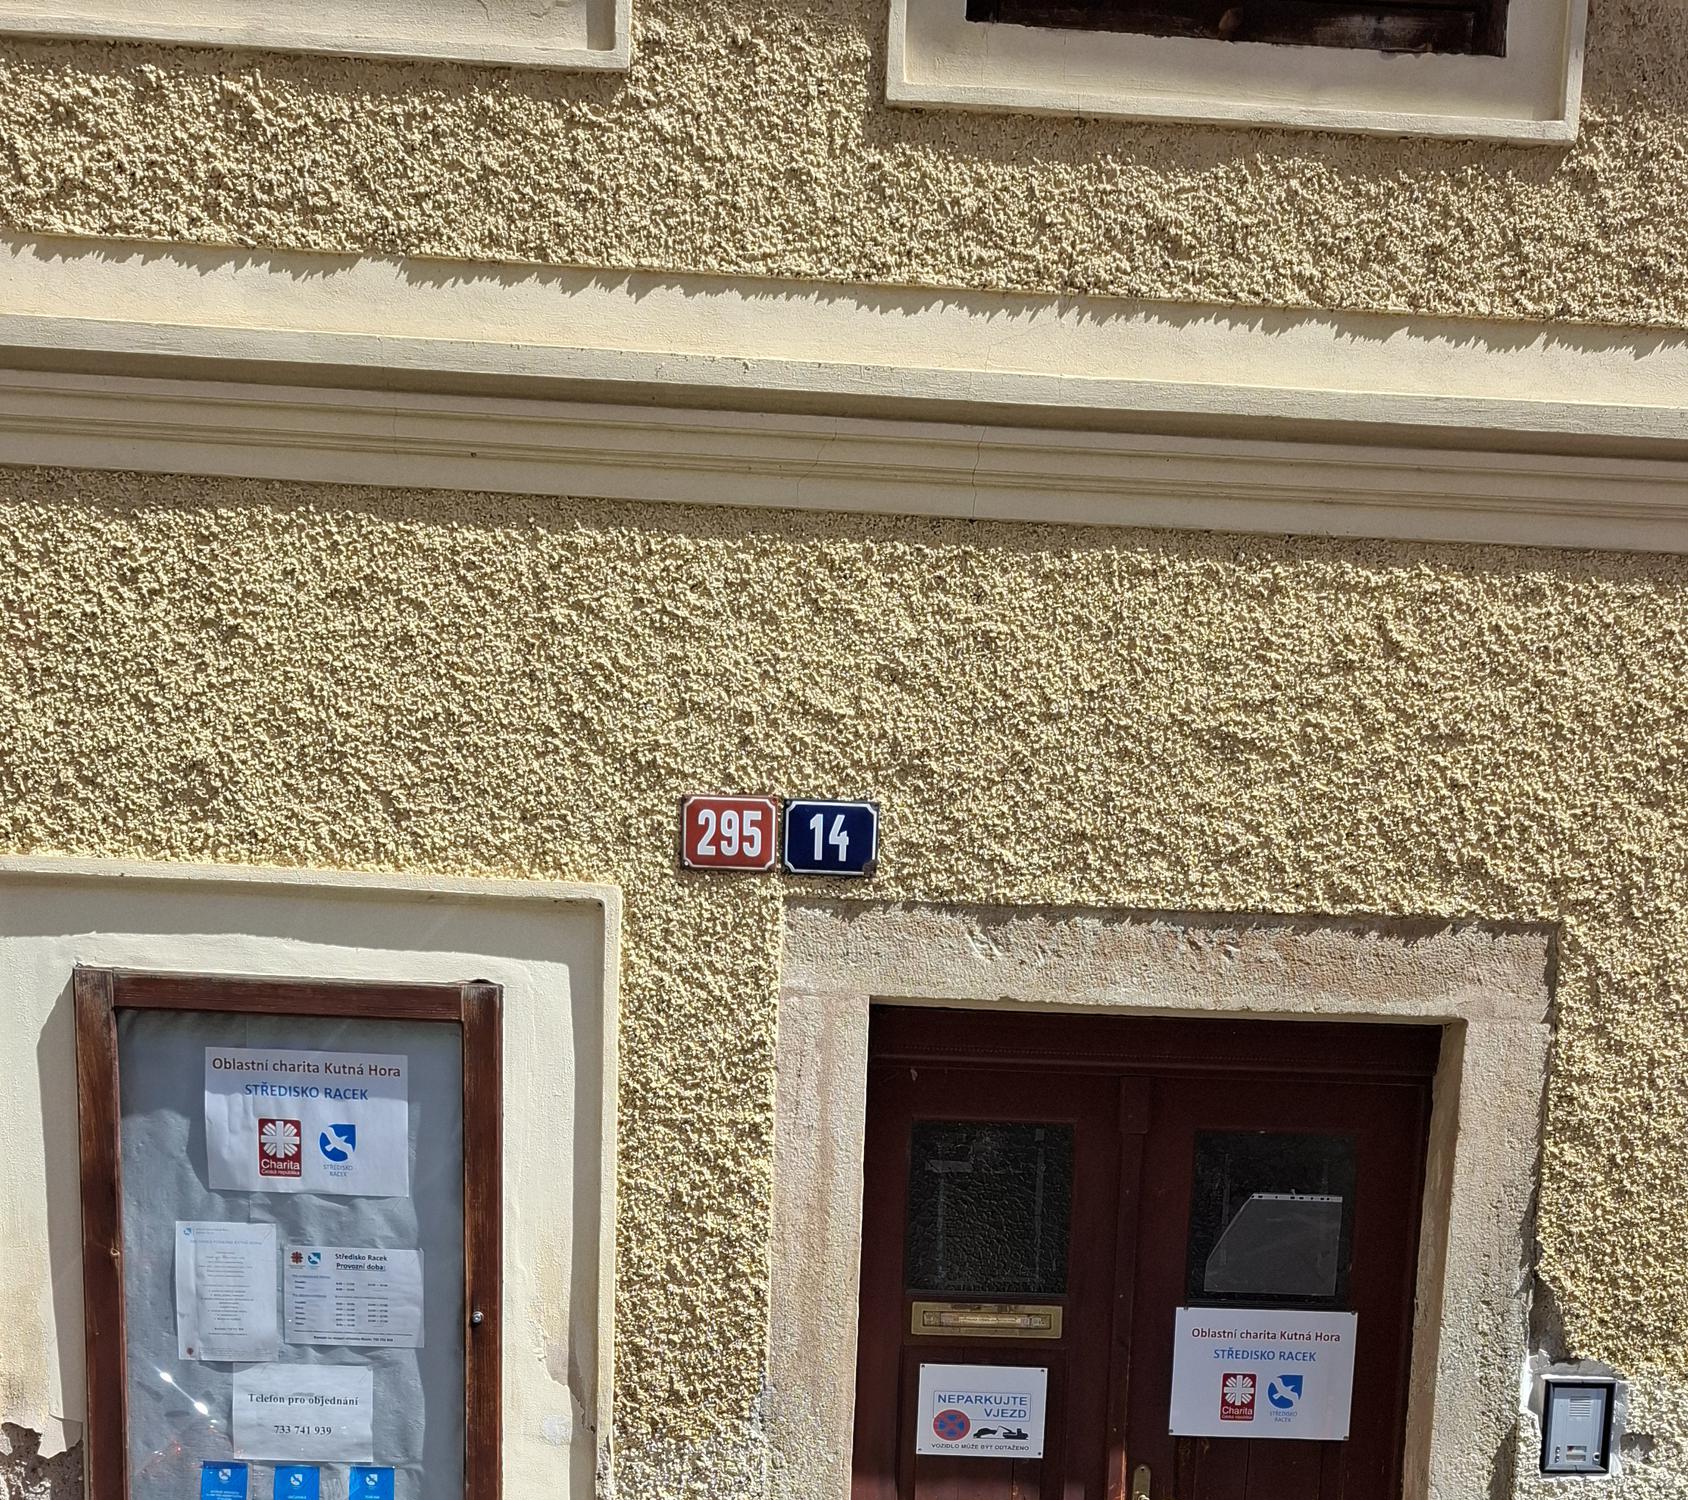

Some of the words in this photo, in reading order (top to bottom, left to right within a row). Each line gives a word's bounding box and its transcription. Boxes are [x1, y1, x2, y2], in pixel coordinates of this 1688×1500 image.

[696, 808, 763, 857] 295
[809, 813, 850, 862] 14
[212, 1057, 269, 1072] Oblastní
[272, 1062, 320, 1074] charita
[324, 1063, 364, 1076] Kutná
[368, 1065, 401, 1077] Hora
[244, 1082, 320, 1098] STŘEDISKO
[324, 1087, 369, 1101] RACEK
[261, 1159, 300, 1171] Charita
[1192, 1328, 1237, 1340] Oblastní
[1240, 1330, 1277, 1341] charita
[1280, 1330, 1312, 1342] Kutná
[1315, 1332, 1340, 1342] Hora
[1213, 1347, 1275, 1361] STŘEDISKO
[1278, 1350, 1316, 1362] RACEK
[248, 1393, 285, 1403] Telefon
[288, 1397, 305, 1406] pro
[308, 1396, 358, 1406] objednání
[937, 1394, 1028, 1406] NEPARKUJTE
[984, 1408, 1027, 1418] VJEZD
[1222, 1406, 1253, 1415] Charita
[274, 1425, 291, 1434] 733
[294, 1425, 310, 1435] 741
[314, 1426, 332, 1435] 939
